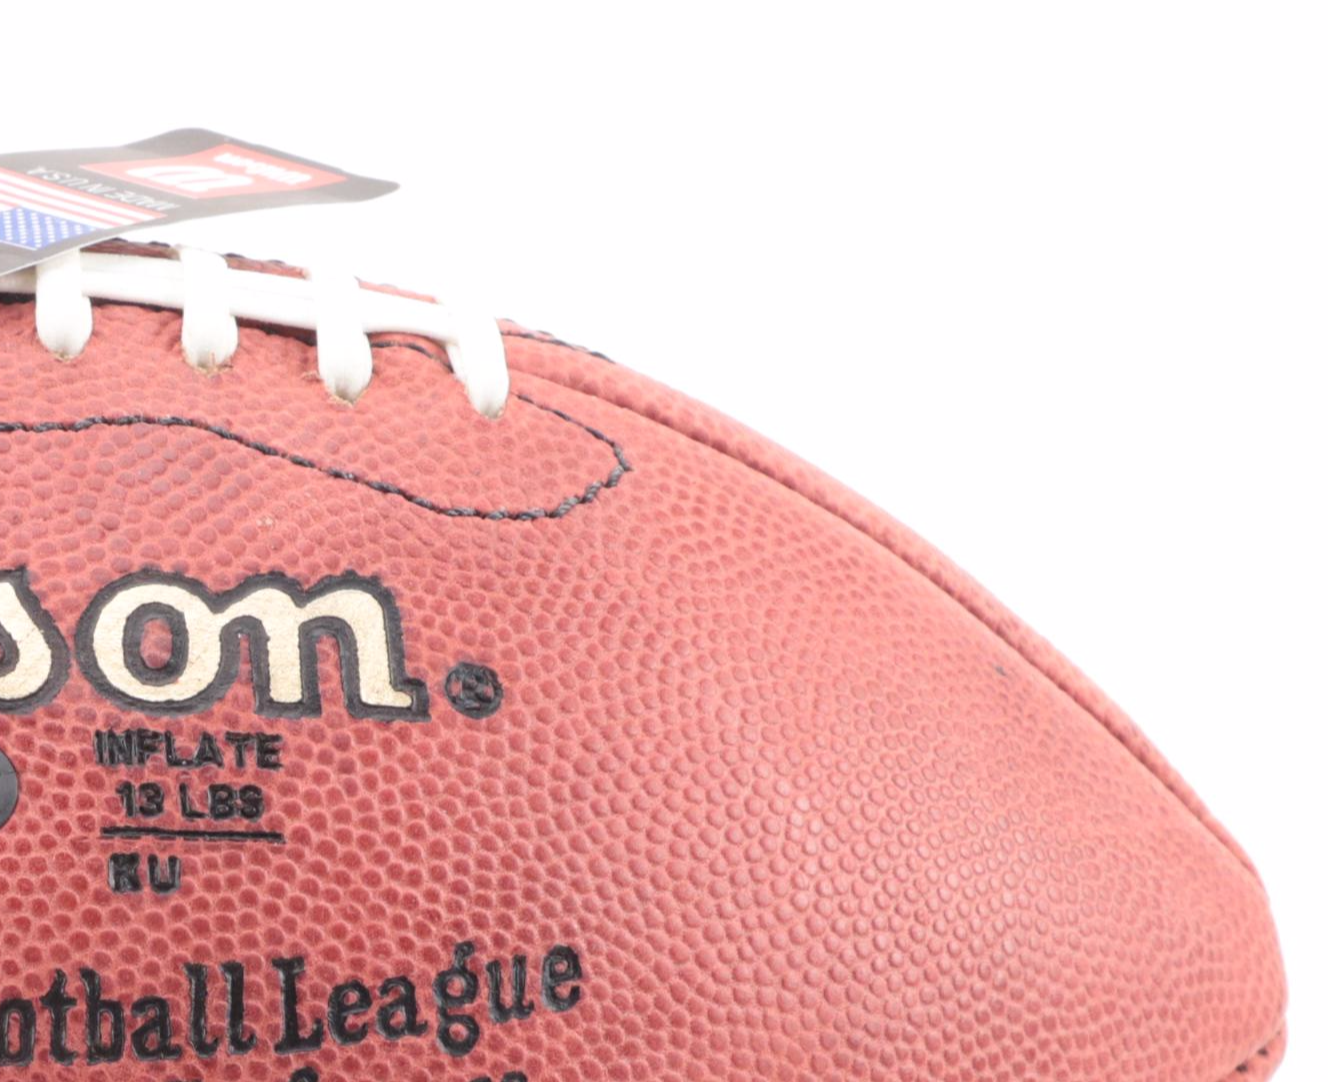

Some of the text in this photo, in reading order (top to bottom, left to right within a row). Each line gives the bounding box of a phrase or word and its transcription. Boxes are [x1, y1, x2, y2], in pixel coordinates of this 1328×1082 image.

[26, 166, 89, 187] USA
[103, 190, 181, 211] MADE
[93, 728, 285, 770] INFLATE
[116, 781, 265, 821] 13 LBS
[271, 940, 583, 1057] League
